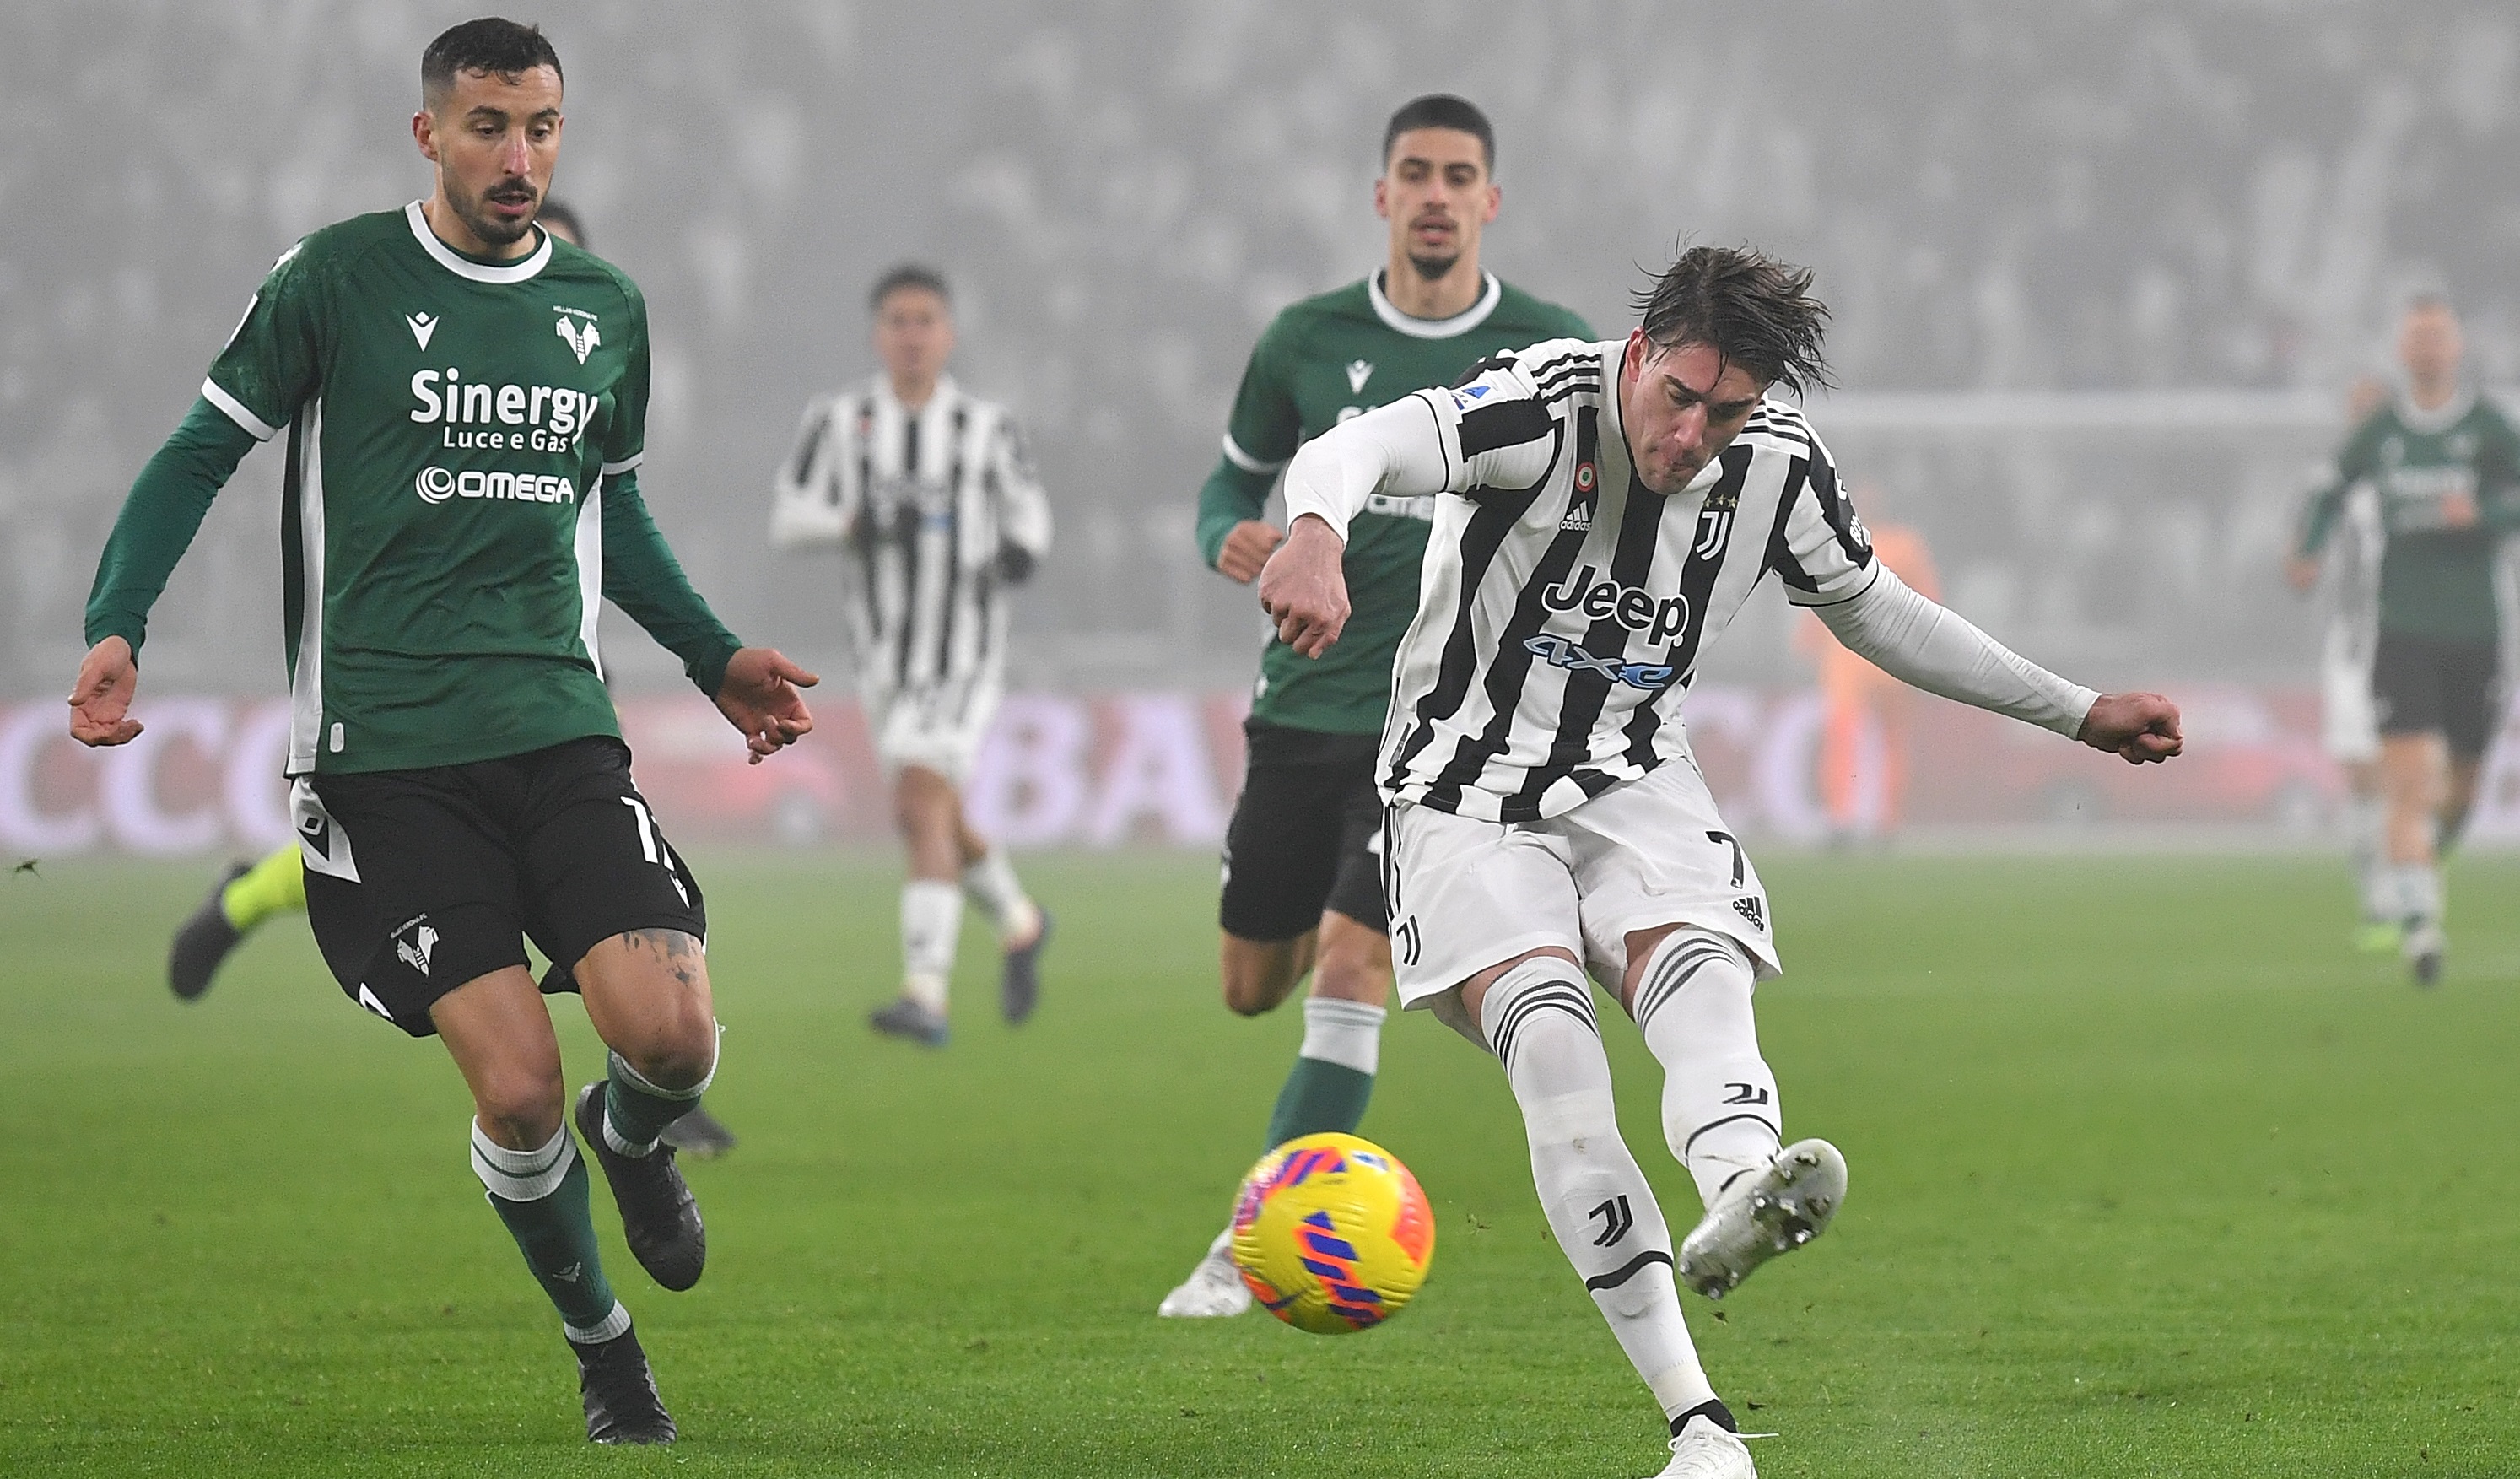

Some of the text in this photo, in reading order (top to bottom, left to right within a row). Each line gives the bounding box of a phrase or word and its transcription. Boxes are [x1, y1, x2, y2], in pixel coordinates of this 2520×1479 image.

[410, 367, 598, 445] Sinergy
[443, 426, 569, 453] Luce e Gas
[457, 471, 575, 504] OMEGA
[1560, 518, 1592, 532] adidas
[1541, 564, 1689, 648] Jeep
[1705, 830, 1744, 889] 7
[1732, 900, 1765, 932] adidas
